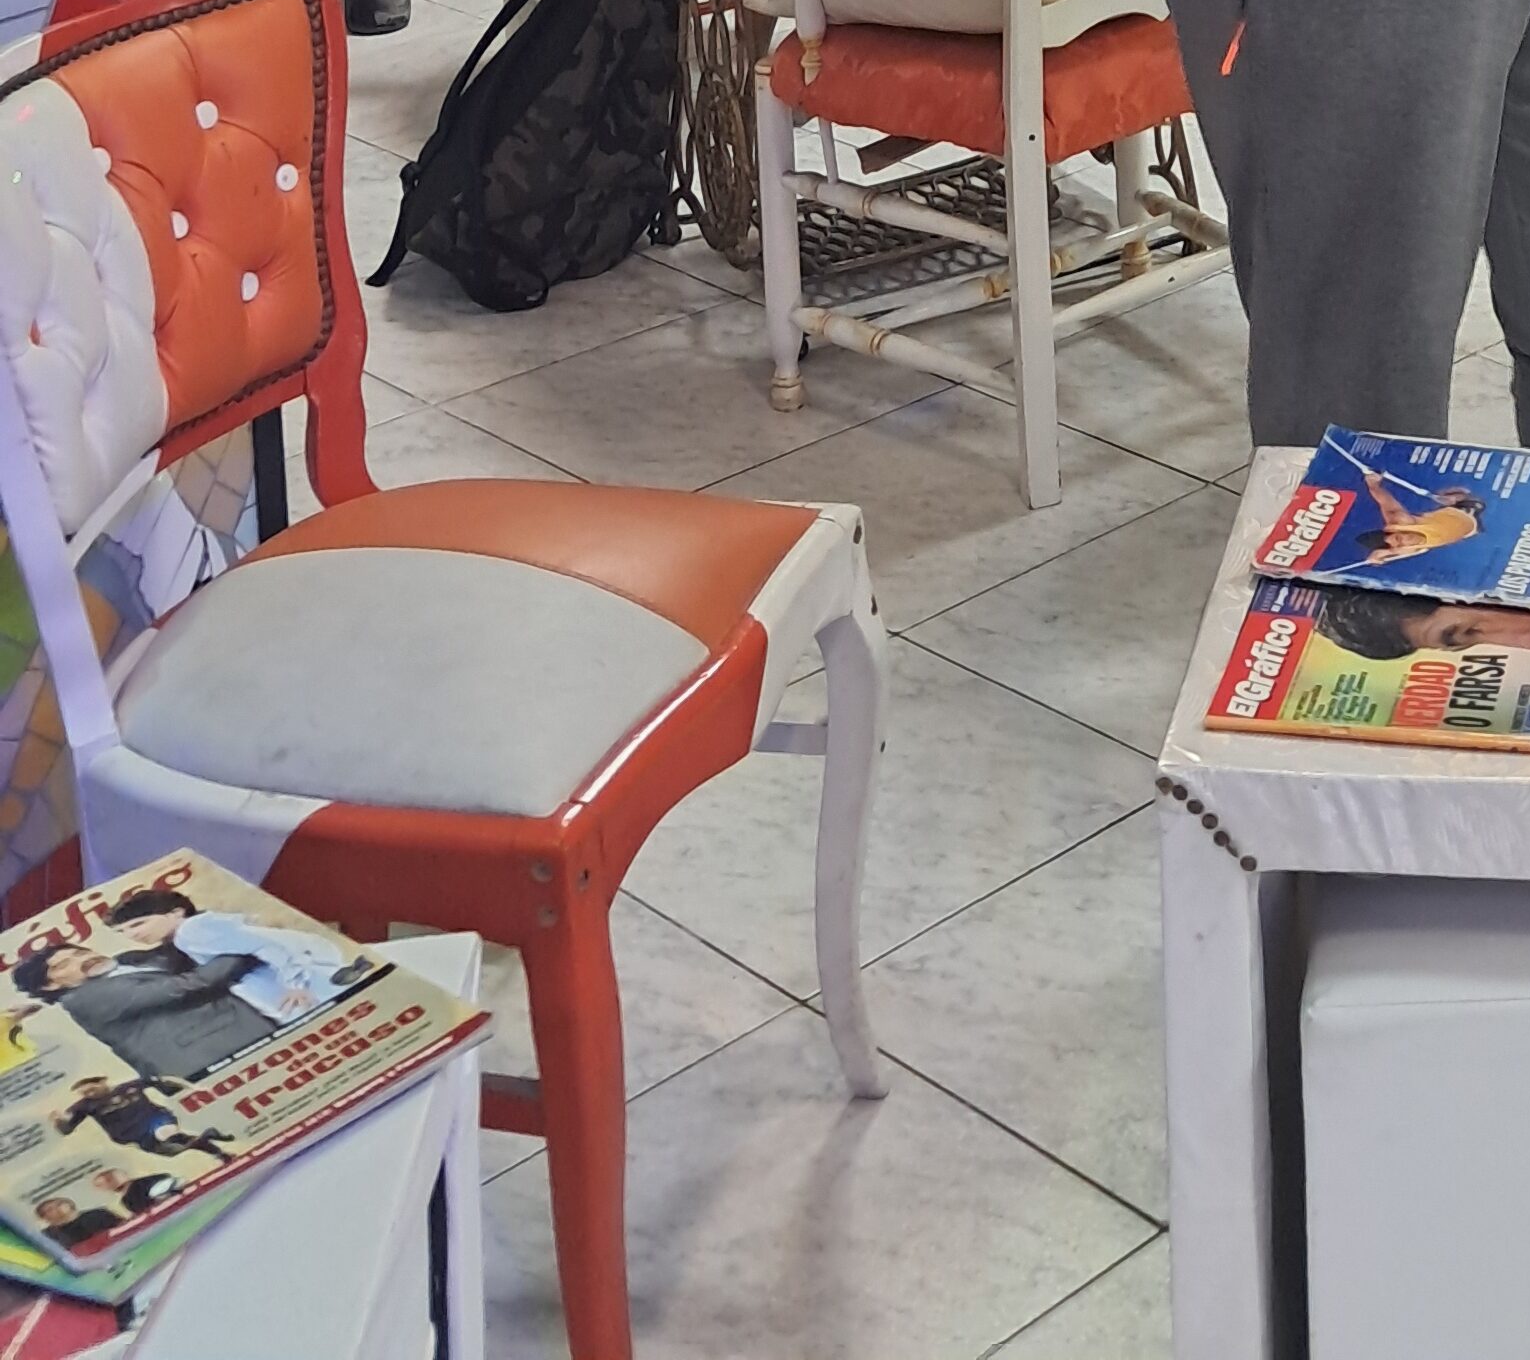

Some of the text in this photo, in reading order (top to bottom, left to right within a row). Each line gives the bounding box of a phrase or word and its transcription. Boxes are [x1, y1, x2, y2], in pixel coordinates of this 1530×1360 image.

[1441, 652, 1510, 731] O FARSA
[233, 1004, 426, 1119] fracaso
